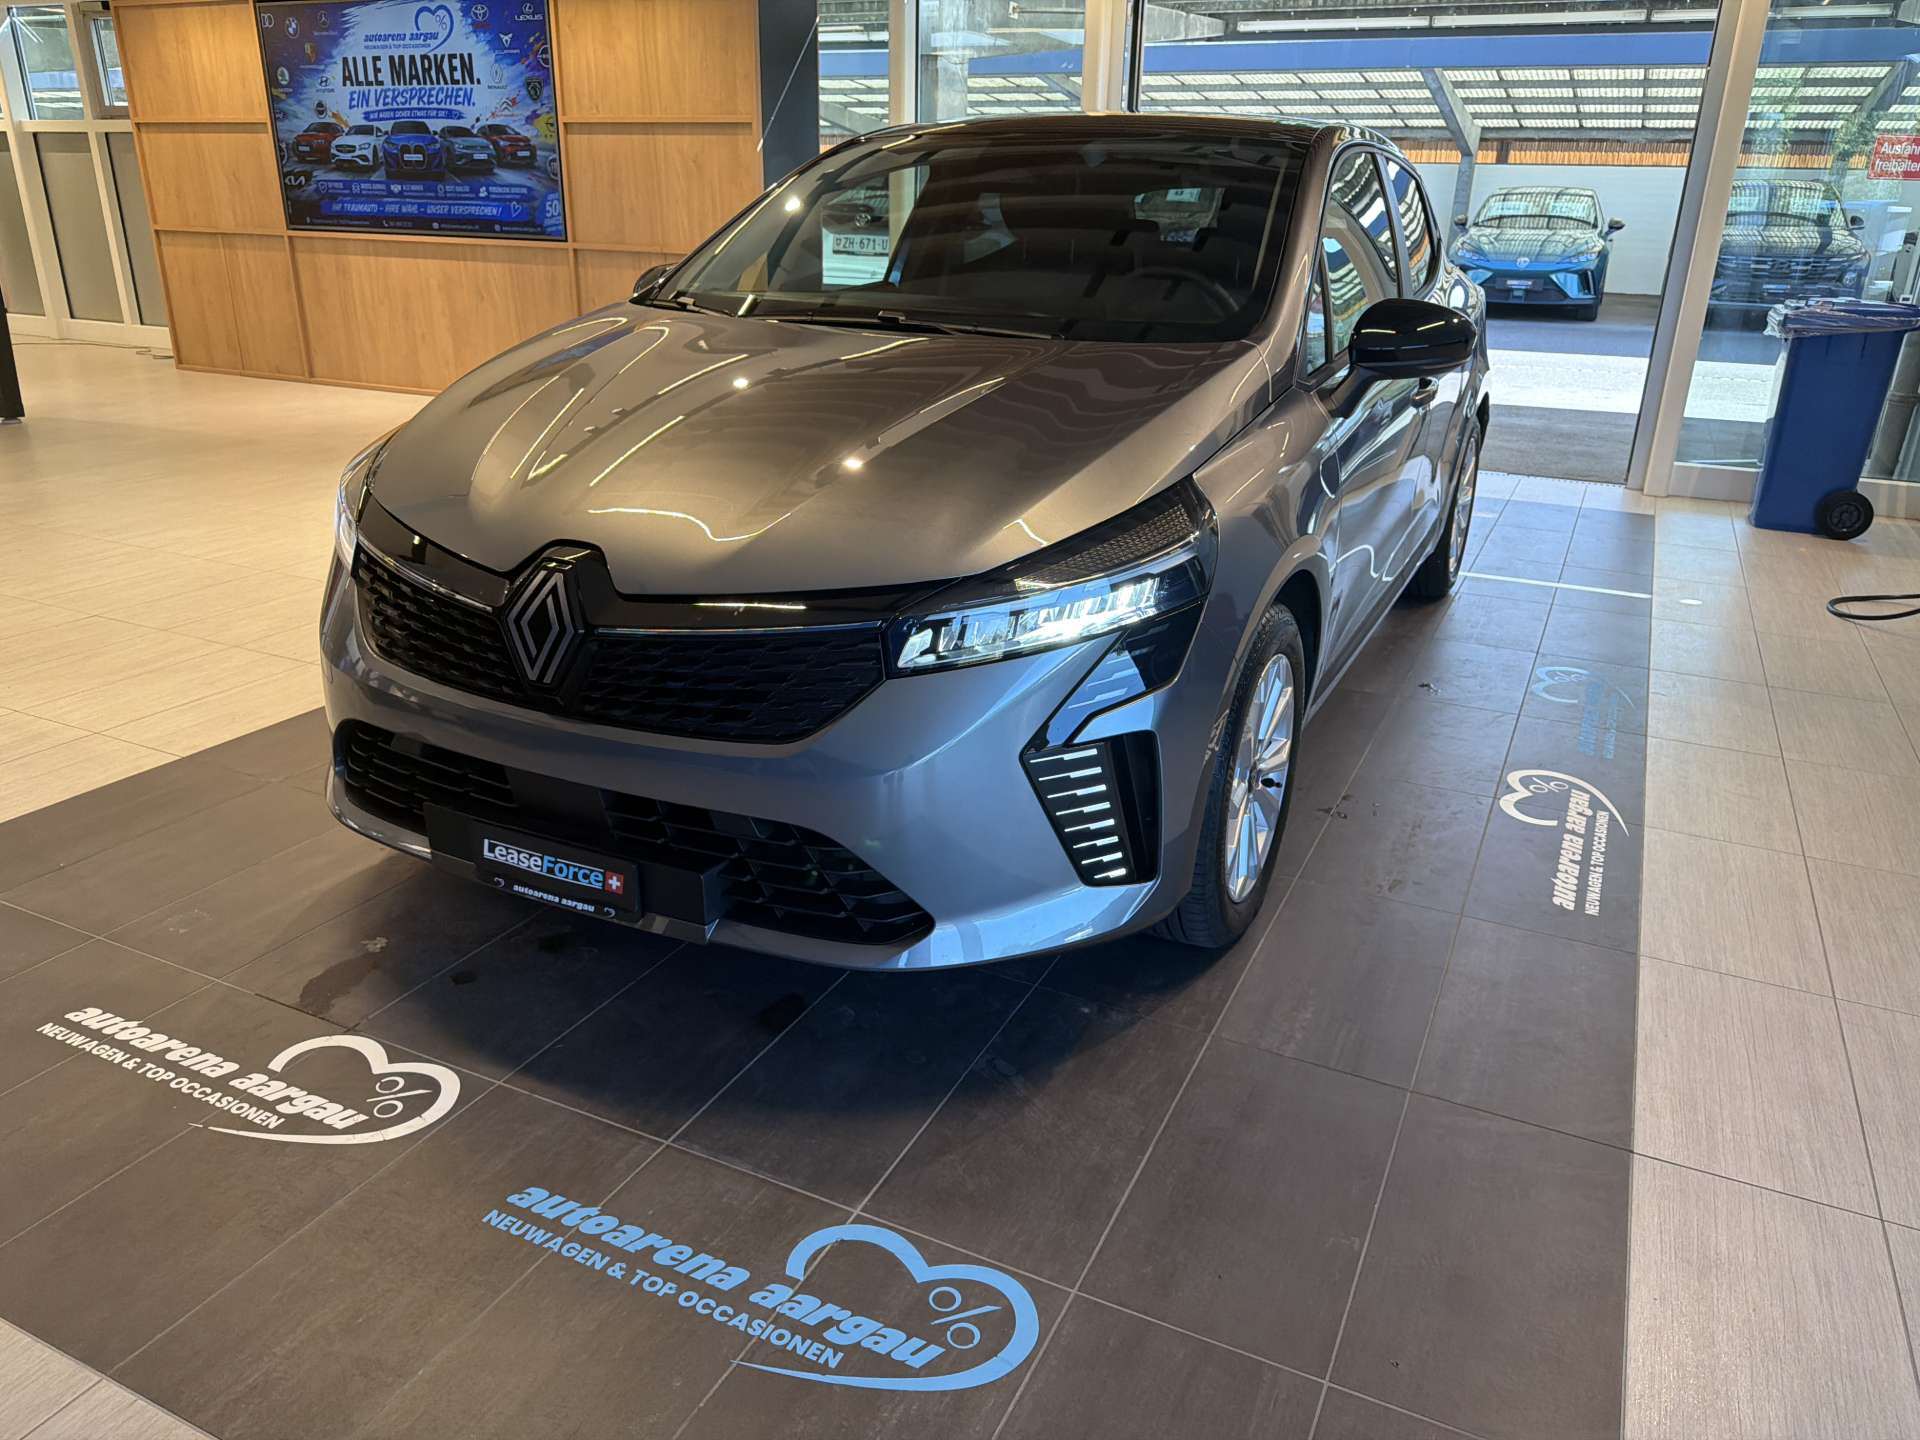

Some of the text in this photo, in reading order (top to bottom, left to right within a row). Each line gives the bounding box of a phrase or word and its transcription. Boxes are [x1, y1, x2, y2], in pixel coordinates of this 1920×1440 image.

[363, 31, 440, 42] autoarena aargau
[342, 53, 481, 87] ALLE MARKEN.
[348, 87, 476, 110] EIN VERSPRECHEN.
[1565, 789, 1593, 834] aargau
[1592, 809, 1609, 852] OCCASIONEN
[483, 838, 604, 888] LeaseForce
[1550, 833, 1585, 911] autoarena
[1590, 851, 1605, 866] TOP
[512, 884, 595, 913] autoarena aargau
[1584, 871, 1603, 917] NEUWAGEN
[35, 1022, 286, 1130] NEUWAGEN & TOP OCCASIONEN
[63, 1007, 370, 1130] autoarena aargau
[481, 1209, 845, 1369] NEUWAGEN & TOP OCCASIONEN
[505, 1187, 947, 1369] autoarena aargau
